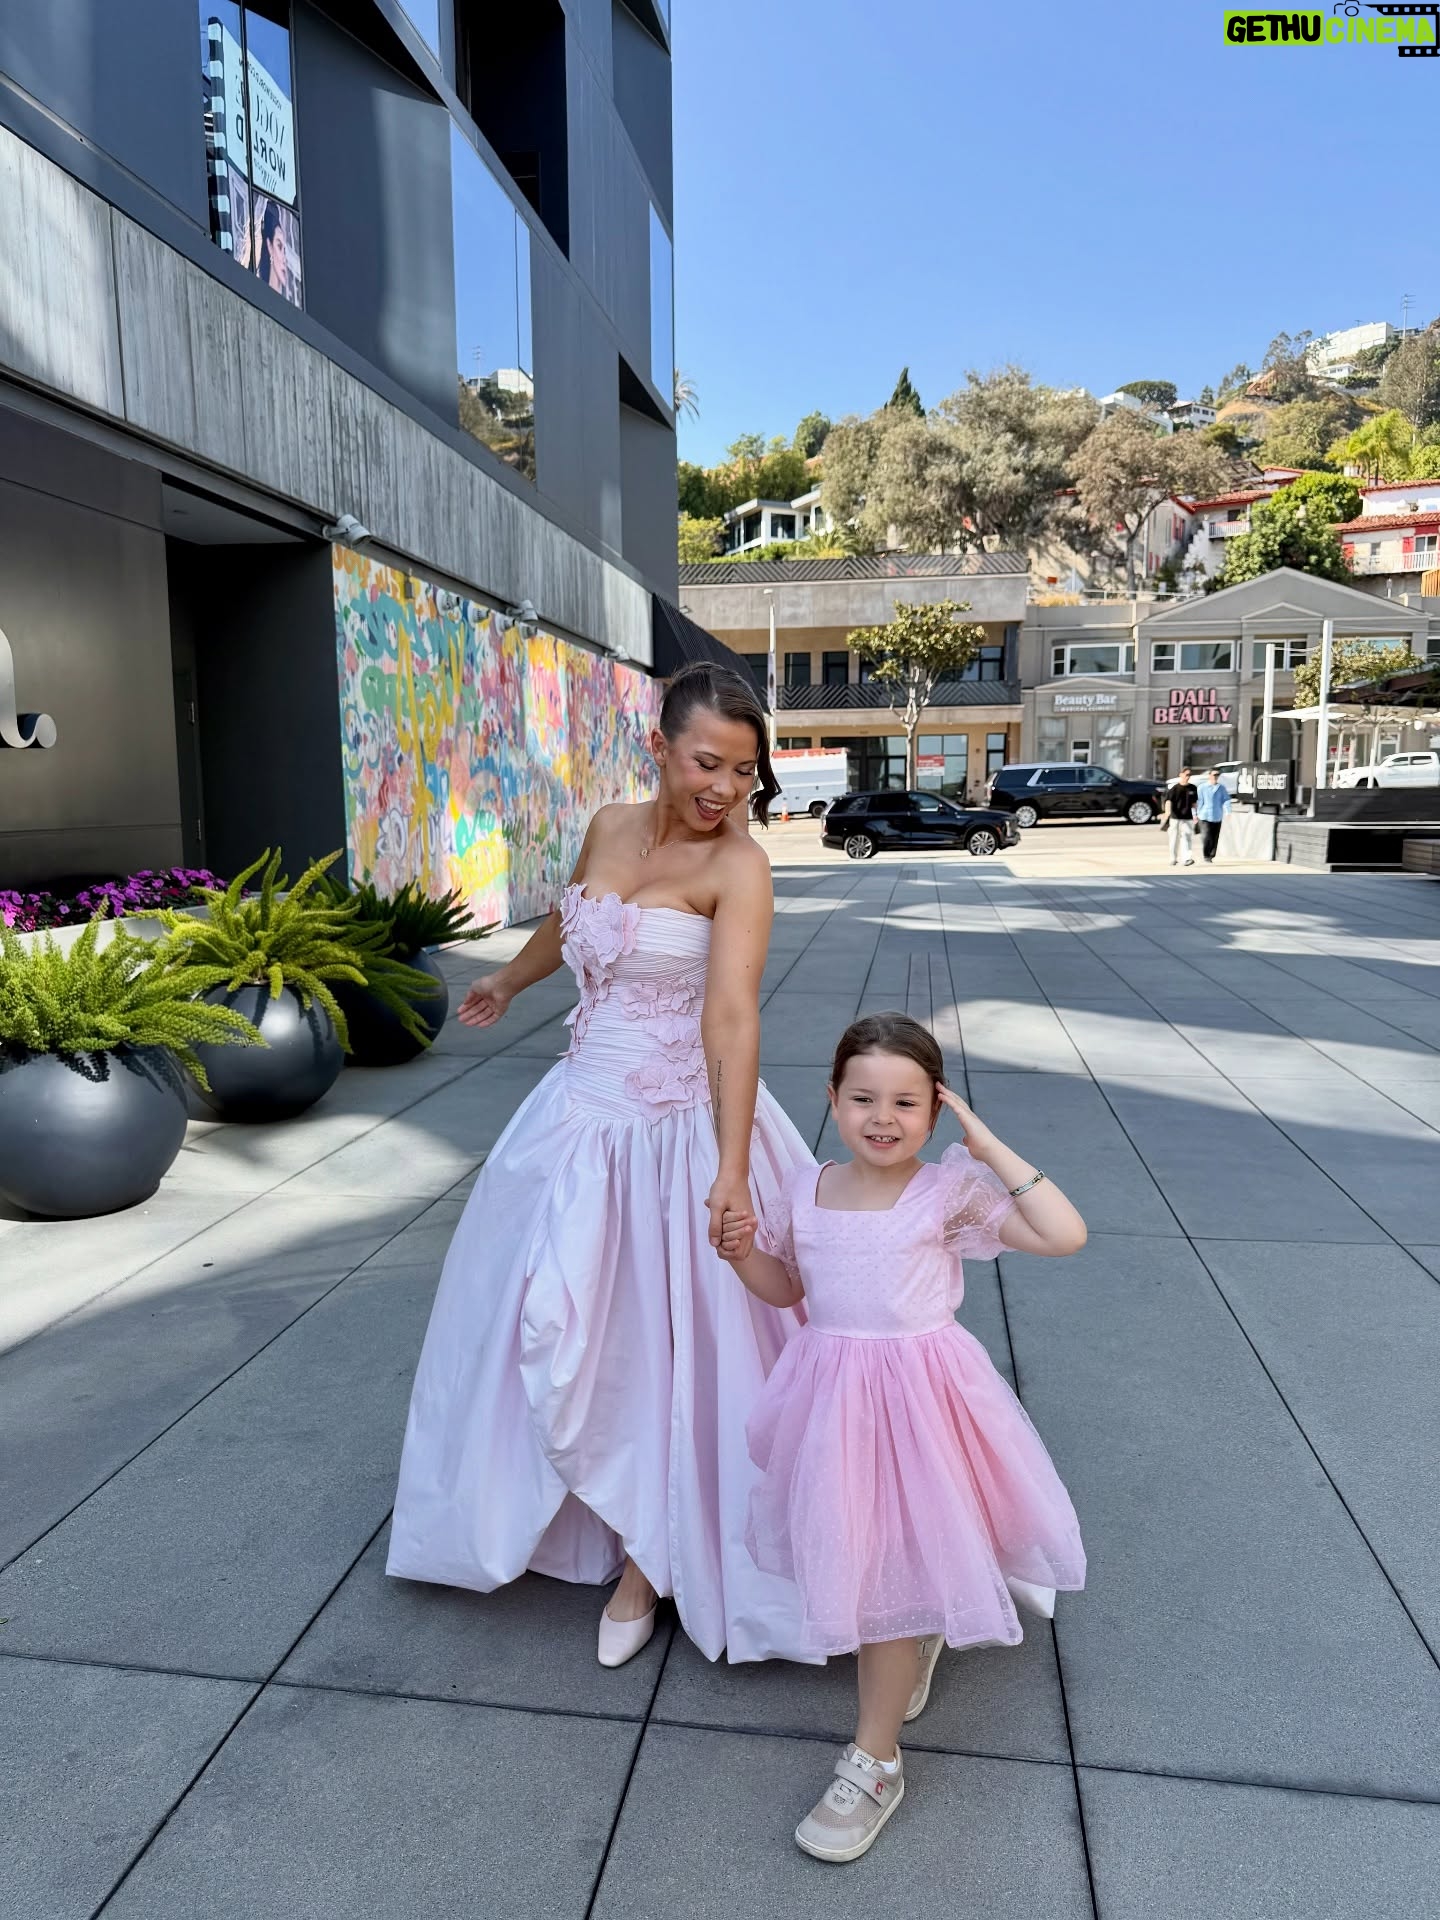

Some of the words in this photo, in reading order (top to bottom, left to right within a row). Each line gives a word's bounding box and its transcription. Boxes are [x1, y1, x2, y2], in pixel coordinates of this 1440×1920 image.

[1054, 694, 1095, 707] Beauty
[1096, 693, 1118, 705] Bar
[1170, 688, 1217, 706] DALI
[1153, 705, 1232, 724] BEAUTY
